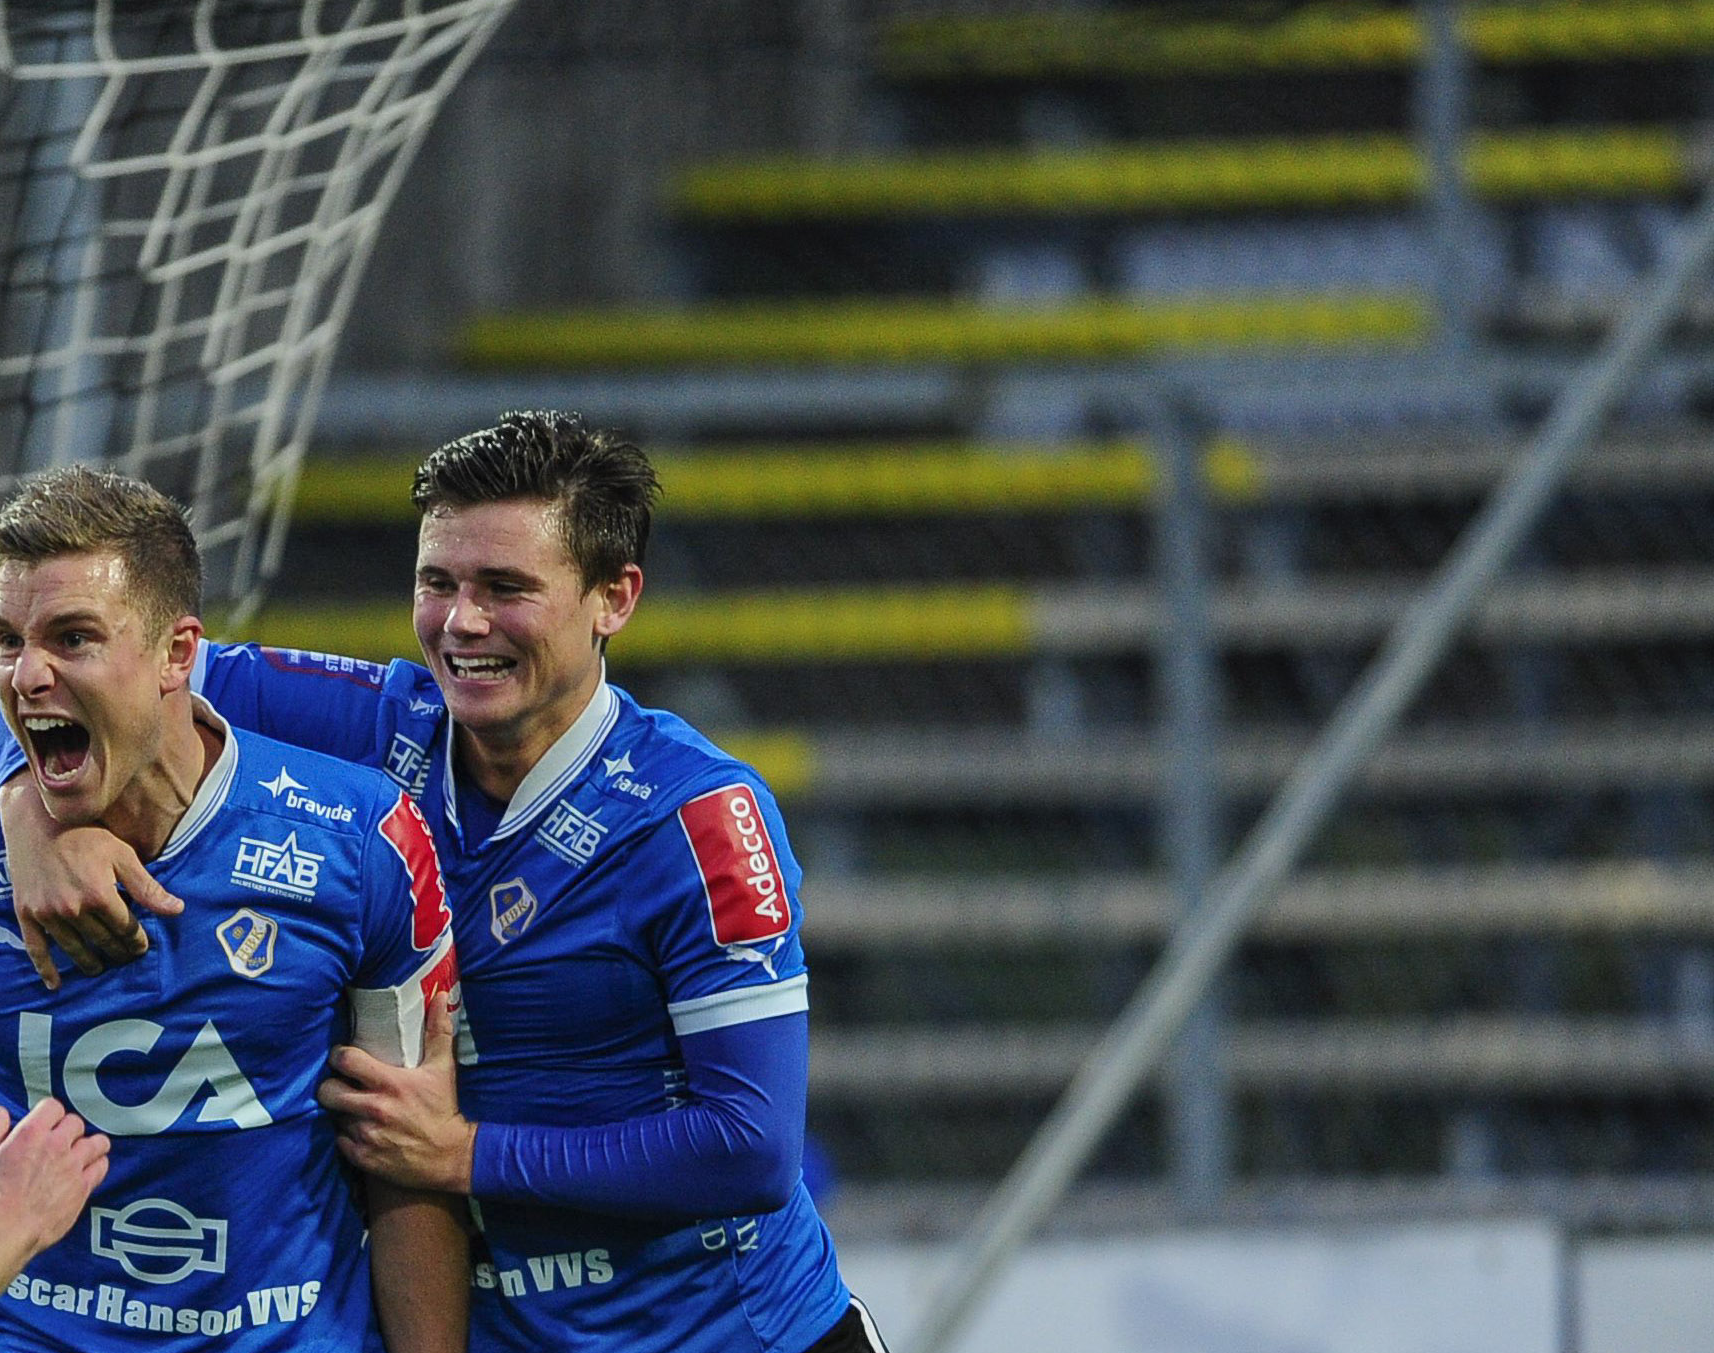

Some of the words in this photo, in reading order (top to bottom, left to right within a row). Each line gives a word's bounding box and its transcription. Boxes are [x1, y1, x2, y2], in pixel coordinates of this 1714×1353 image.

[286, 790, 353, 823] bravida
[541, 804, 601, 858] HFAB
[234, 842, 320, 889] HFAB
[729, 796, 783, 924] Adecco
[18, 1011, 274, 1136] ICA
[526, 1248, 615, 1293] VVS
[6, 1272, 243, 1337] scarHanson
